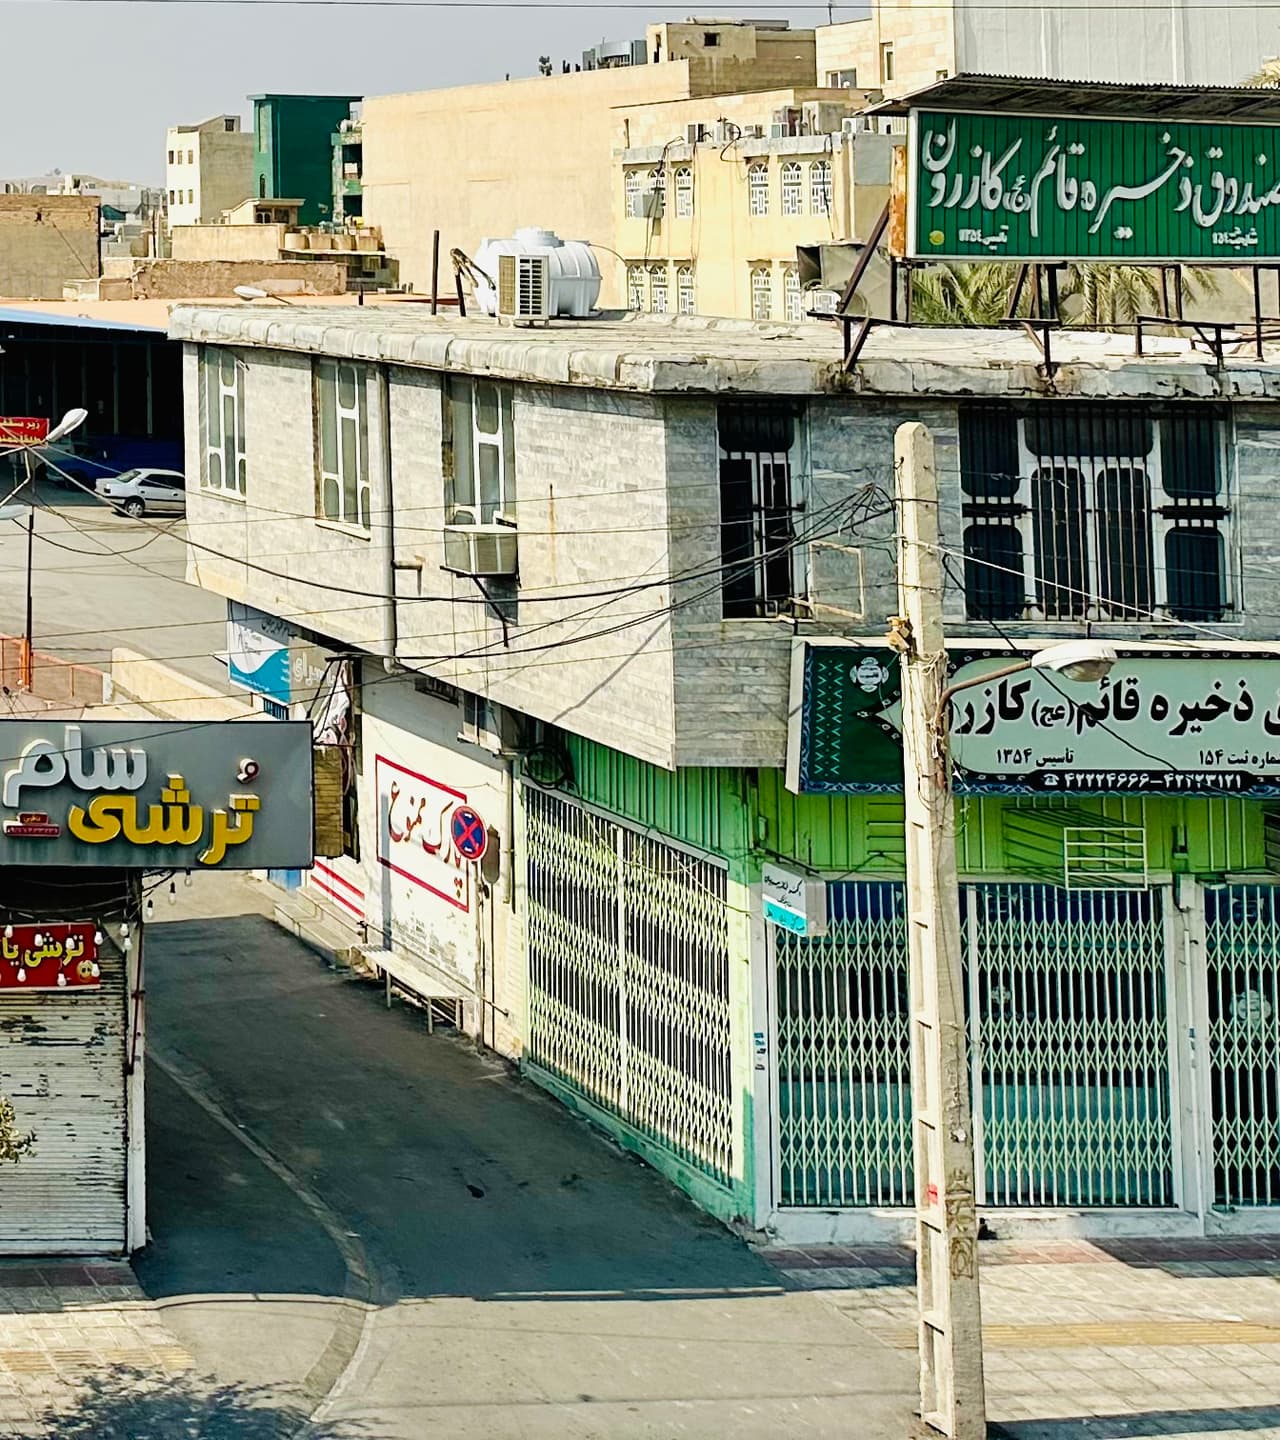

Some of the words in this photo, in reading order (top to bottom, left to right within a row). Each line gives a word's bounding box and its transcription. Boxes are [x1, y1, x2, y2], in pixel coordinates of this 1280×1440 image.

[922, 118, 1022, 210] کازرون
[1080, 131, 1193, 241] ذخیره
[1149, 679, 1254, 737] ذخیره
[1, 726, 149, 808] سام
[996, 747, 1033, 765] ۱۳۵۴
[1199, 749, 1224, 765] ۱۵۴
[1251, 751, 1280, 769] ماره
[25, 931, 85, 968] ترشی
